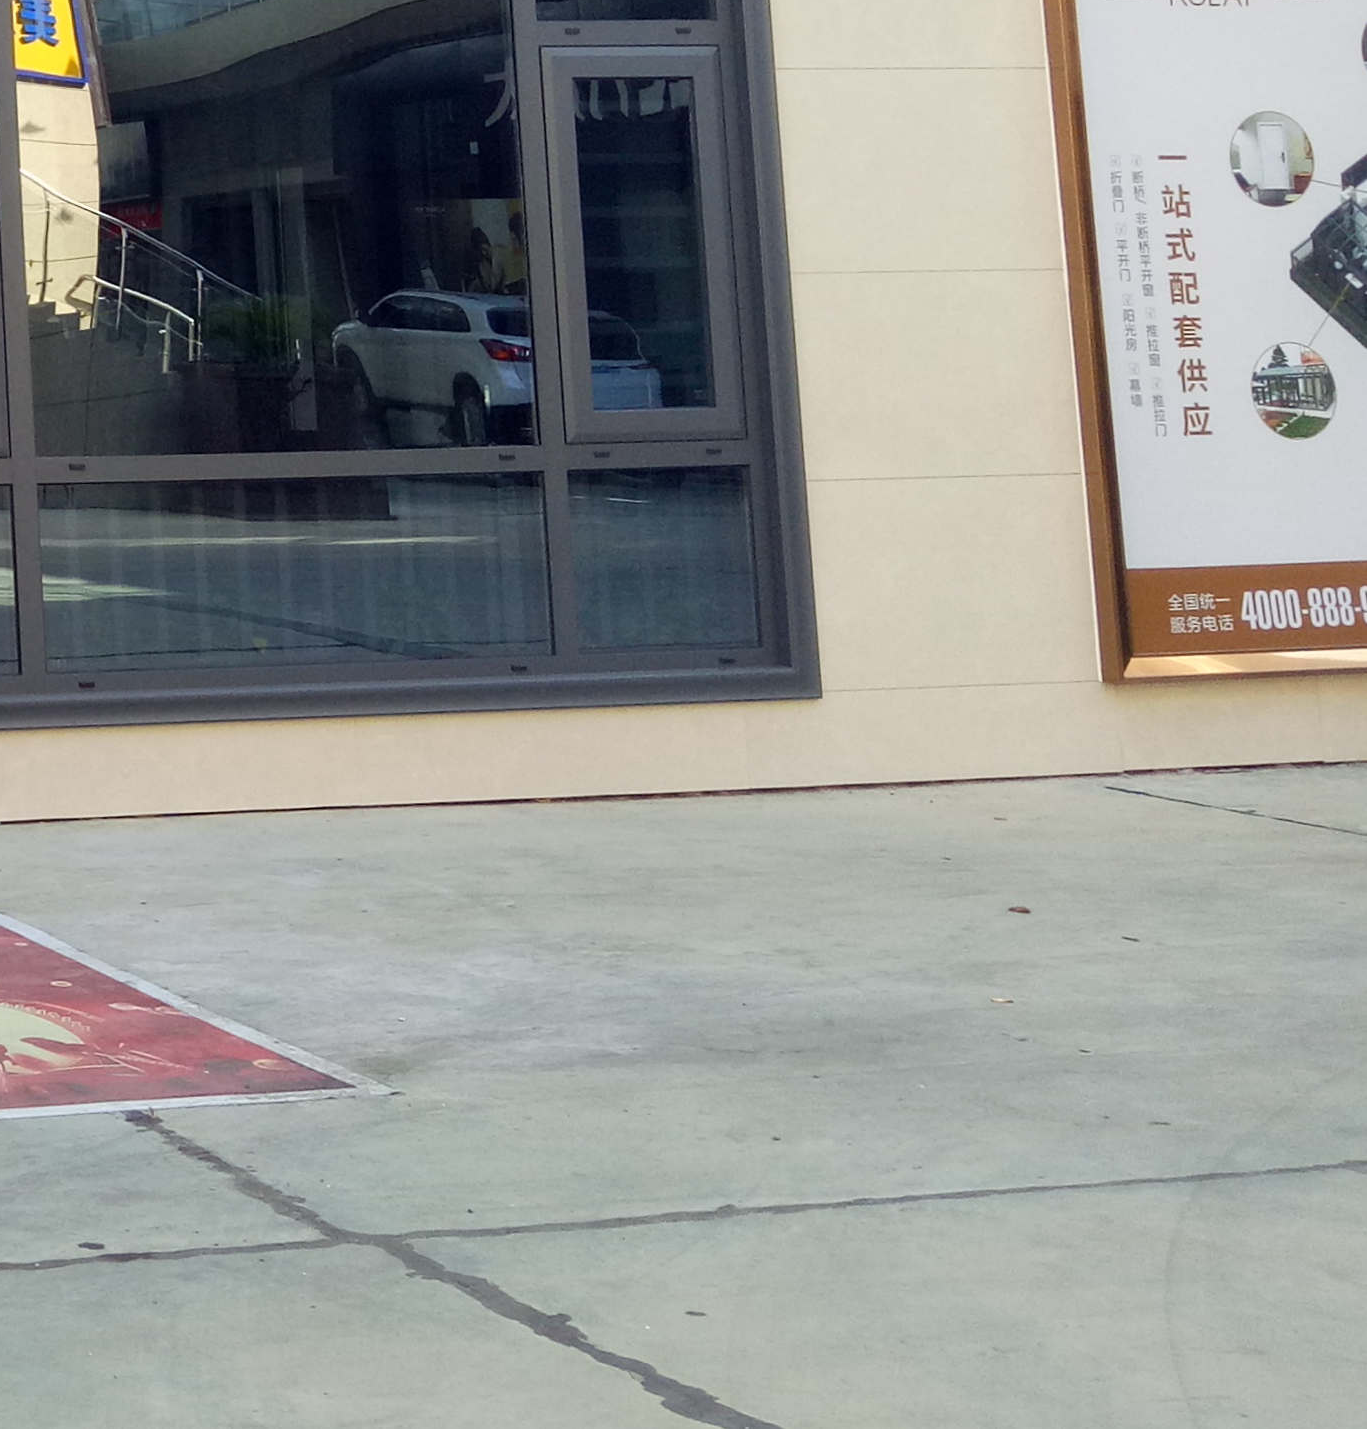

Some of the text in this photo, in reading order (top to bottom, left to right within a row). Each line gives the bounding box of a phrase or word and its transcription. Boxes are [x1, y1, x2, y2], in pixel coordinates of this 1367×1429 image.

[1157, 154, 1213, 438] 一站式配套供应
[1168, 592, 1231, 612] 全国统一
[1170, 614, 1234, 635] 服务电话
